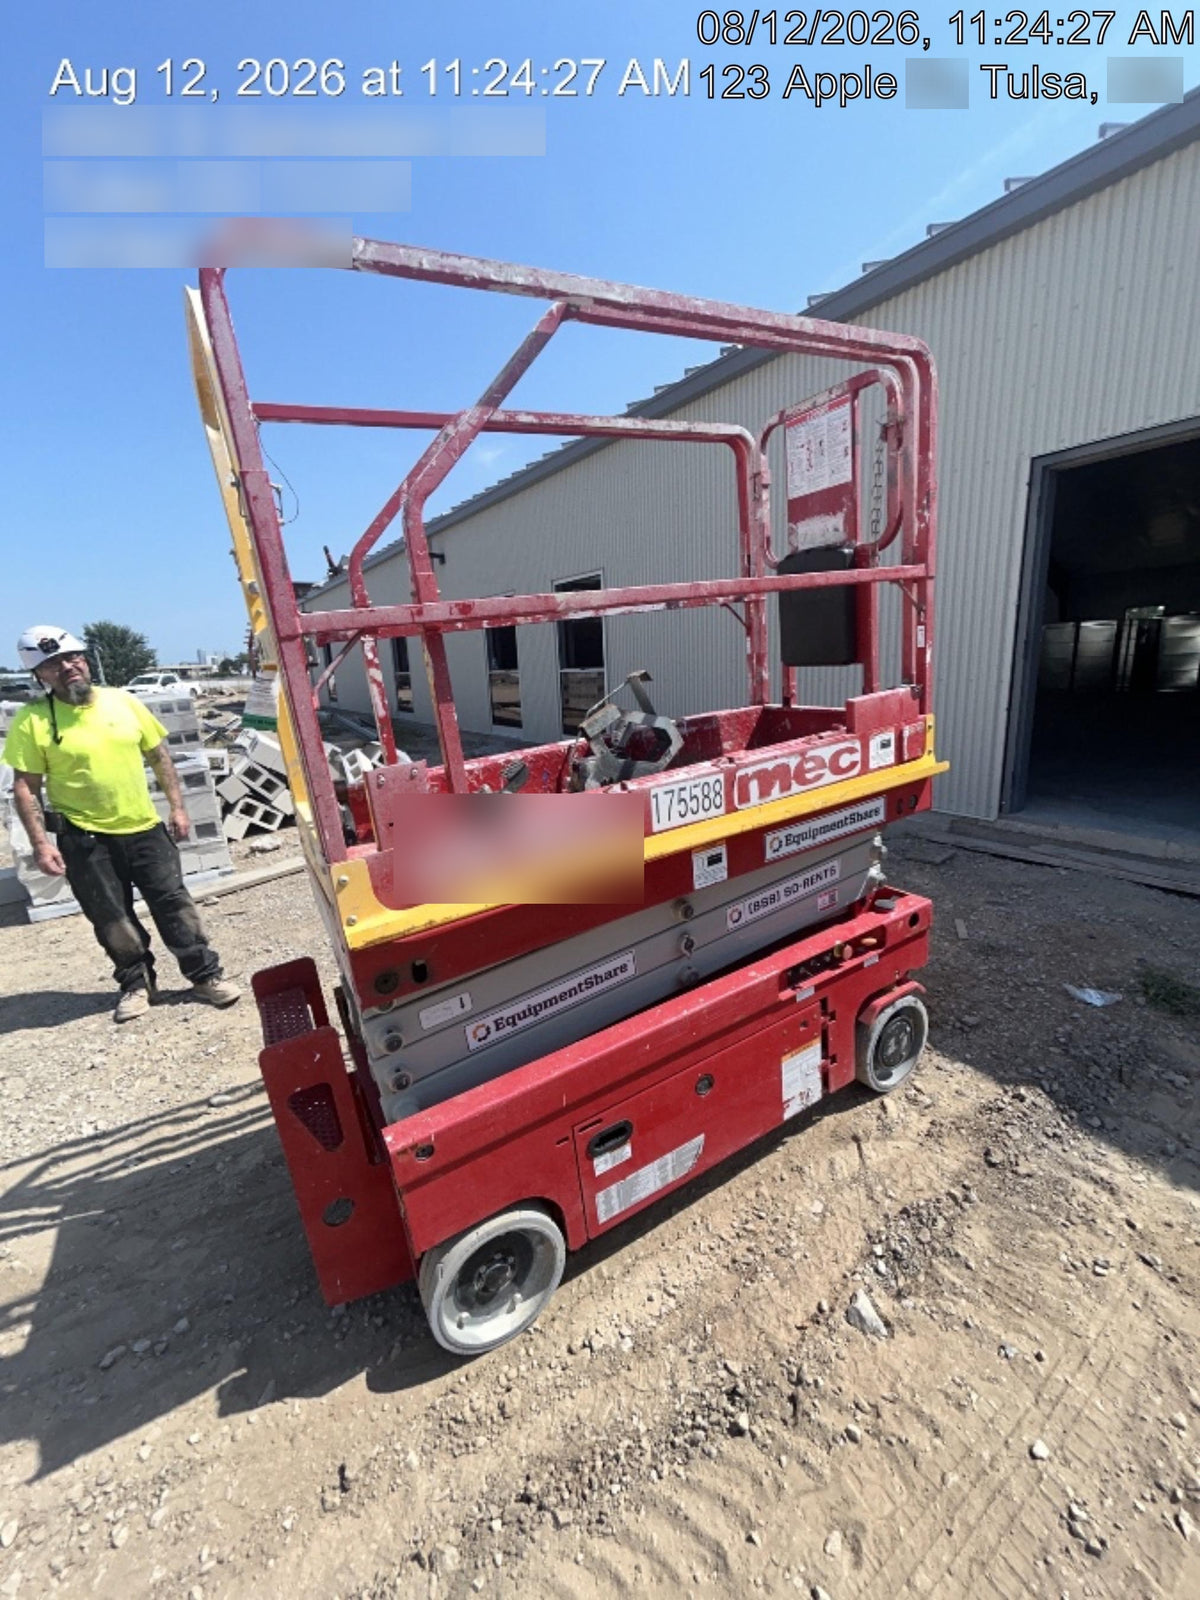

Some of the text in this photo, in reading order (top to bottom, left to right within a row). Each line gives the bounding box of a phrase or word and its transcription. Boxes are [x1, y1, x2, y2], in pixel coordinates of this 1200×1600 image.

[651, 778, 723, 824] 175588
[736, 746, 860, 806] mec
[784, 806, 881, 847] EquipmentShare
[493, 961, 629, 1033] EquipmentShare
